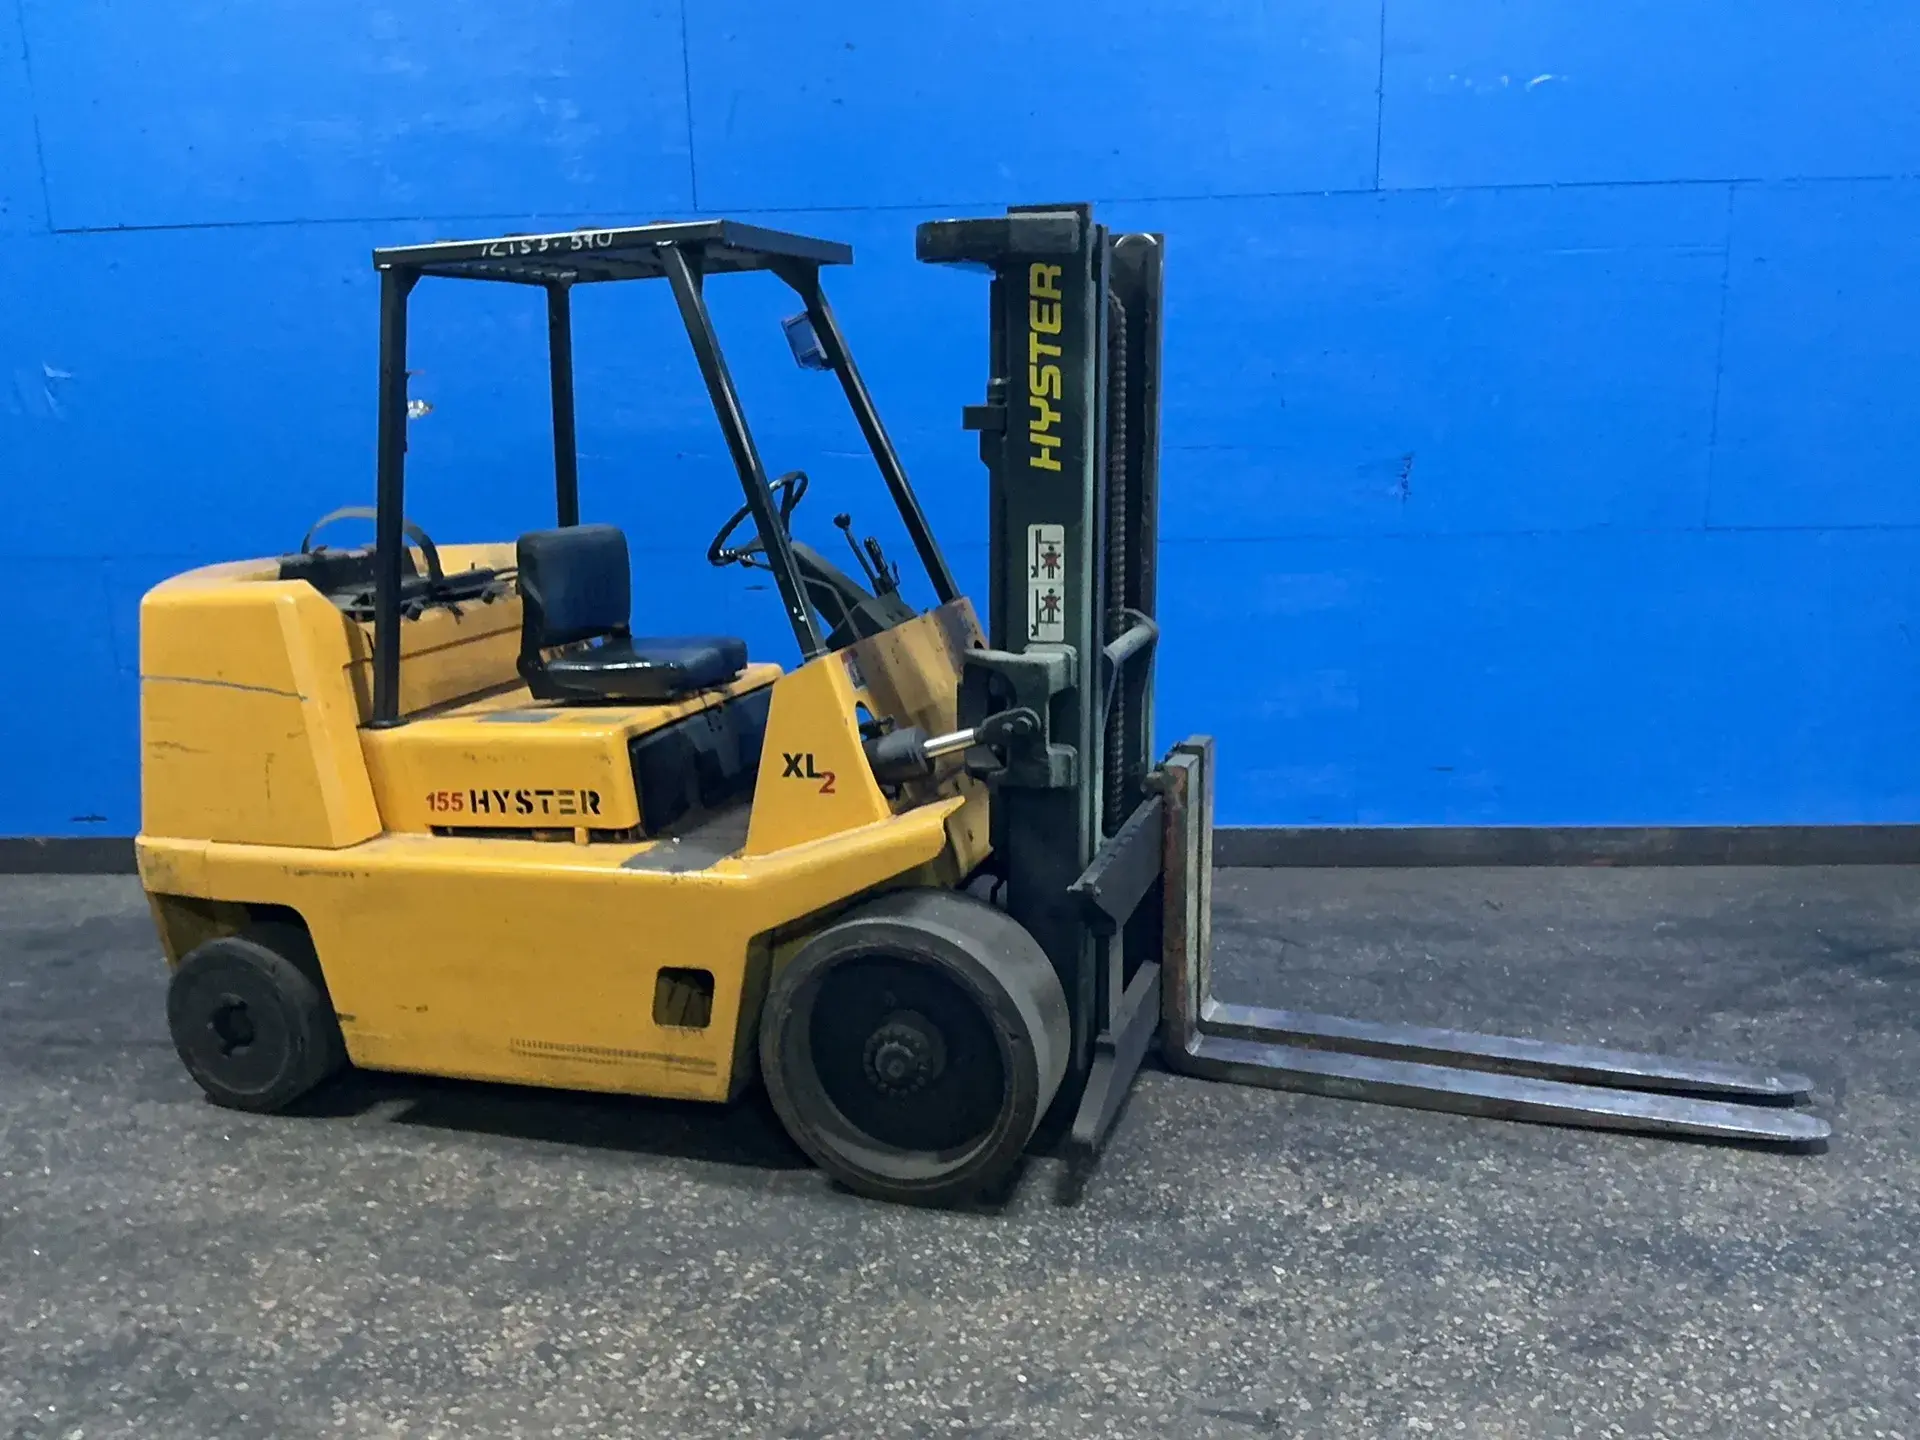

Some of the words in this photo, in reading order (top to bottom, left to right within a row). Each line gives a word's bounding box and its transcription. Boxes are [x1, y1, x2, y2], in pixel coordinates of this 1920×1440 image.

[1029, 262, 1062, 472] HYSTER
[425, 791, 464, 812] 155
[469, 789, 601, 815] HYSTER
